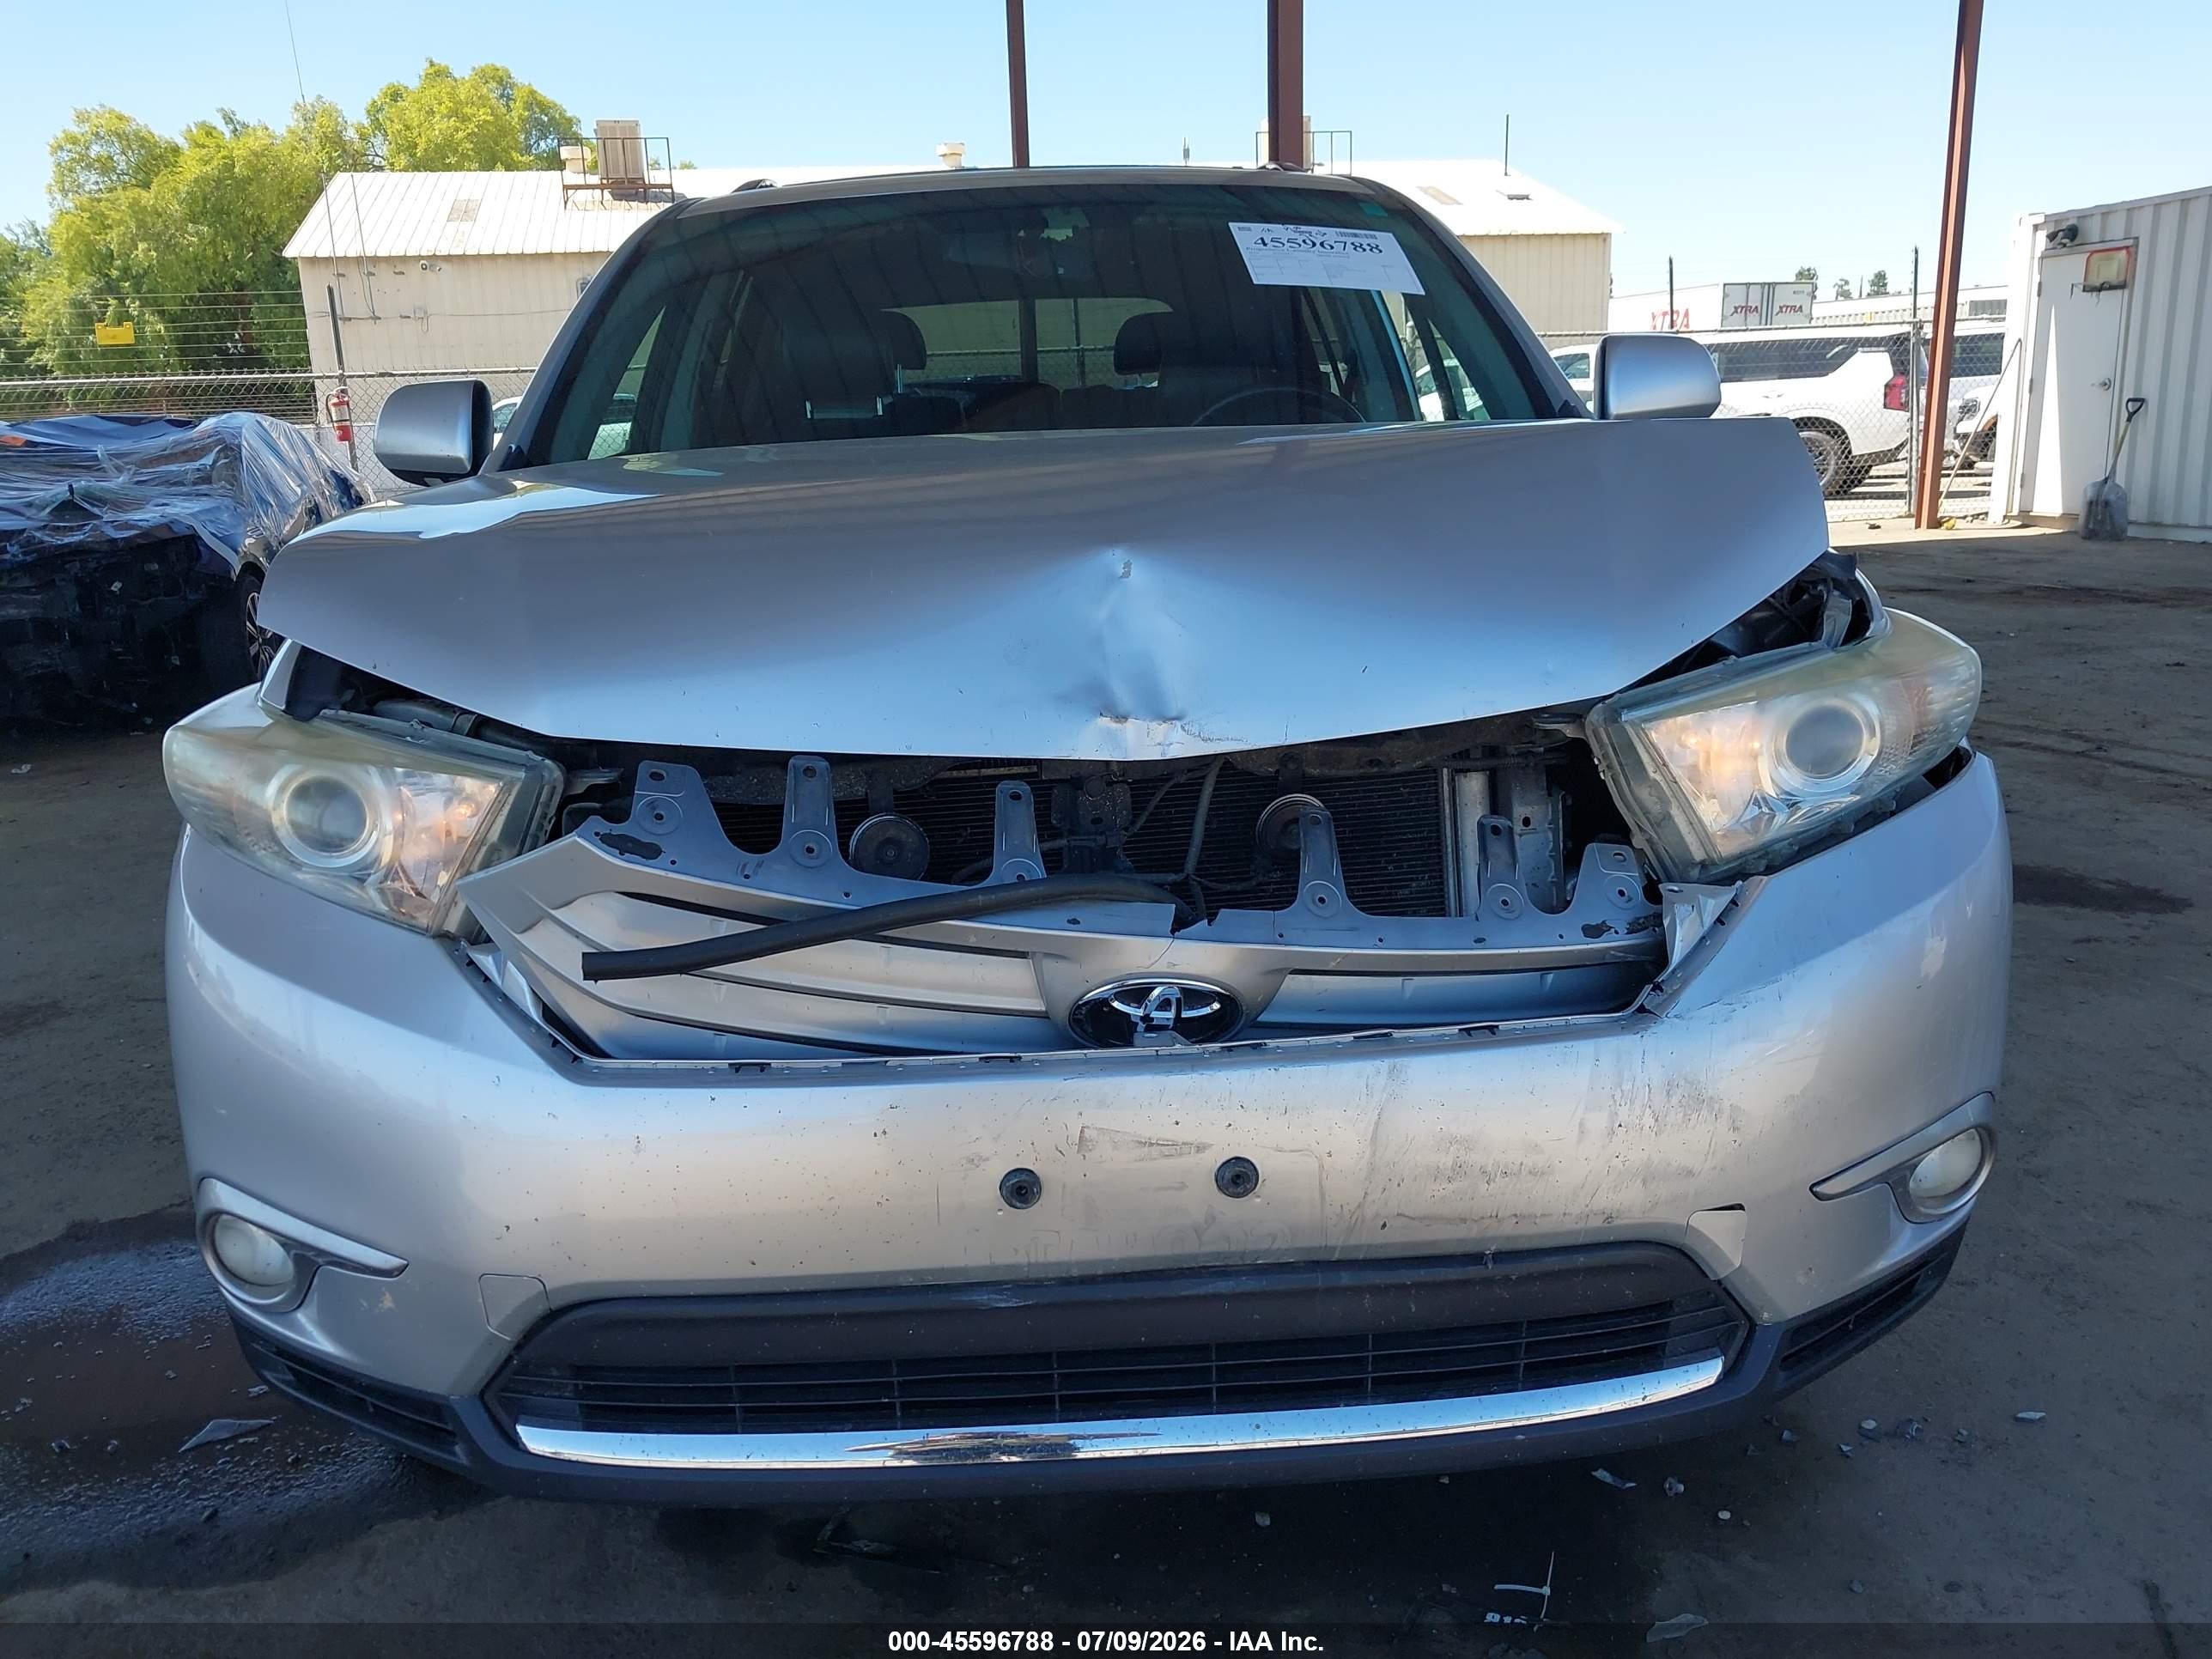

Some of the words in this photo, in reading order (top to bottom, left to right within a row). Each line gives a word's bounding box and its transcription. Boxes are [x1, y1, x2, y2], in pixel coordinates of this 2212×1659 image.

[1253, 235, 1383, 255] 45596788
[1730, 305, 1759, 316] XTRA
[1775, 305, 1803, 316] XTRA
